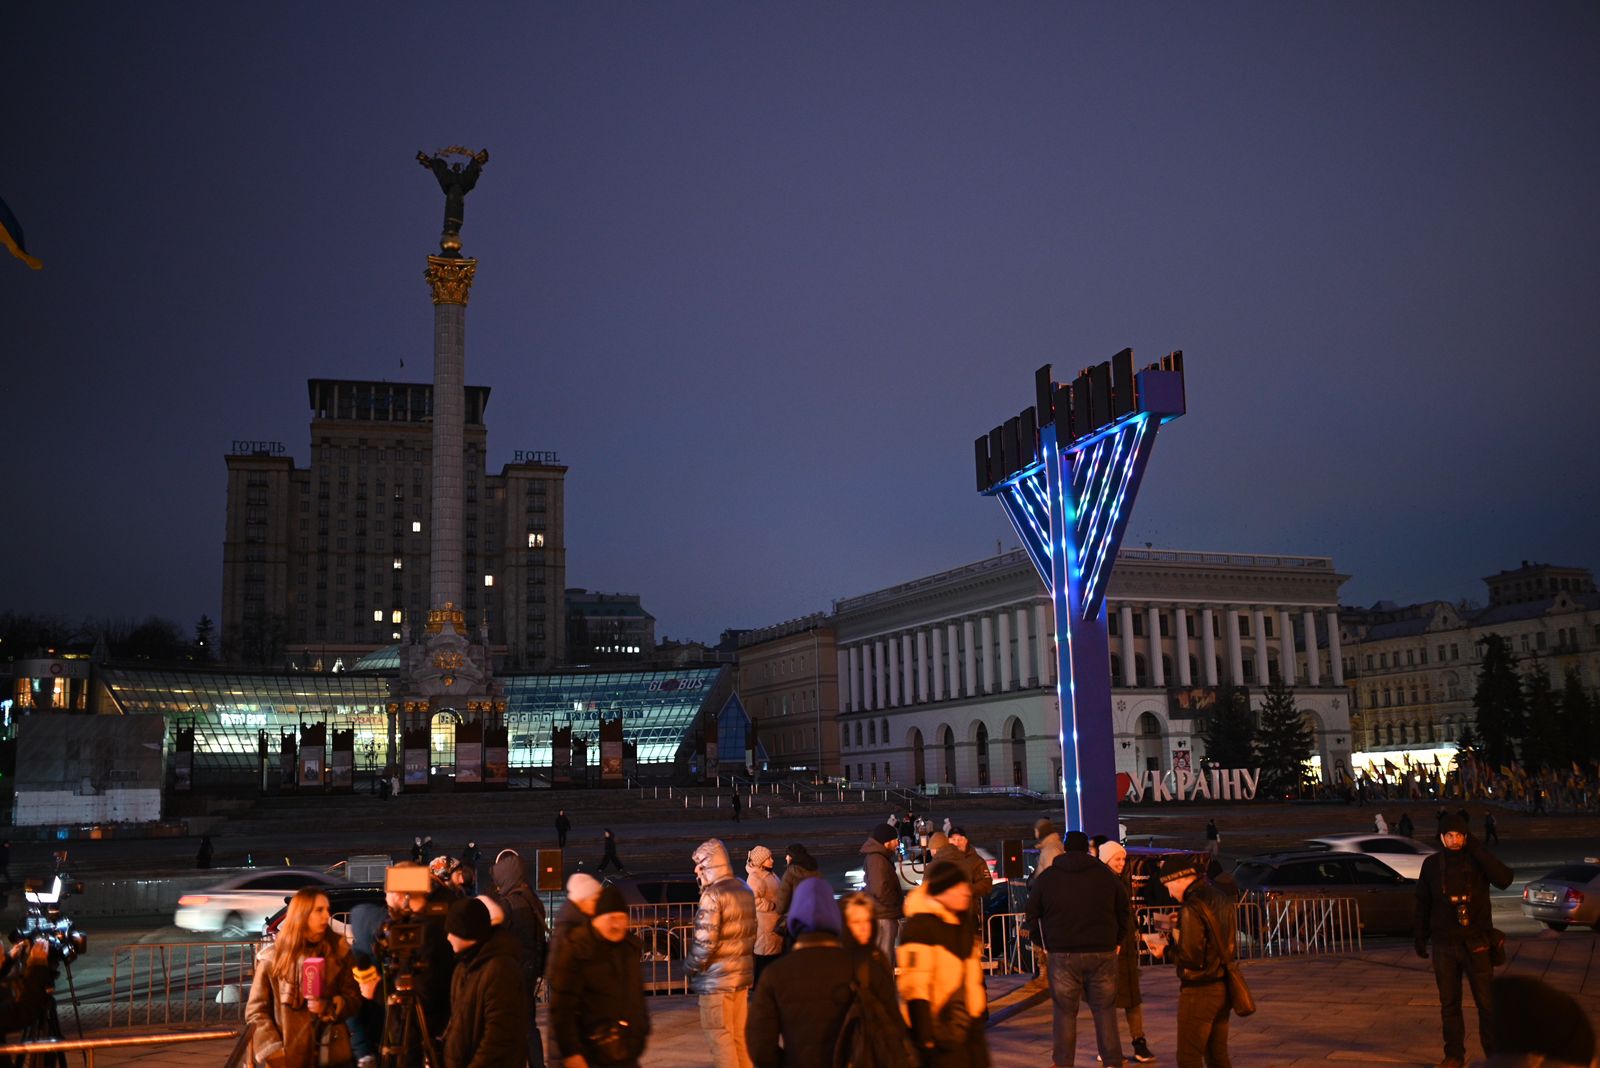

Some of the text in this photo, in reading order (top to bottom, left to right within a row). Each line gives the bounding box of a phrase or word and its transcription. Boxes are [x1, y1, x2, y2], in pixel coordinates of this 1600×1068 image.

[231, 440, 286, 454] ГОТЕЛЬ
[514, 450, 560, 463] HOTEL
[1125, 761, 1260, 803] УКРАЇНУ
